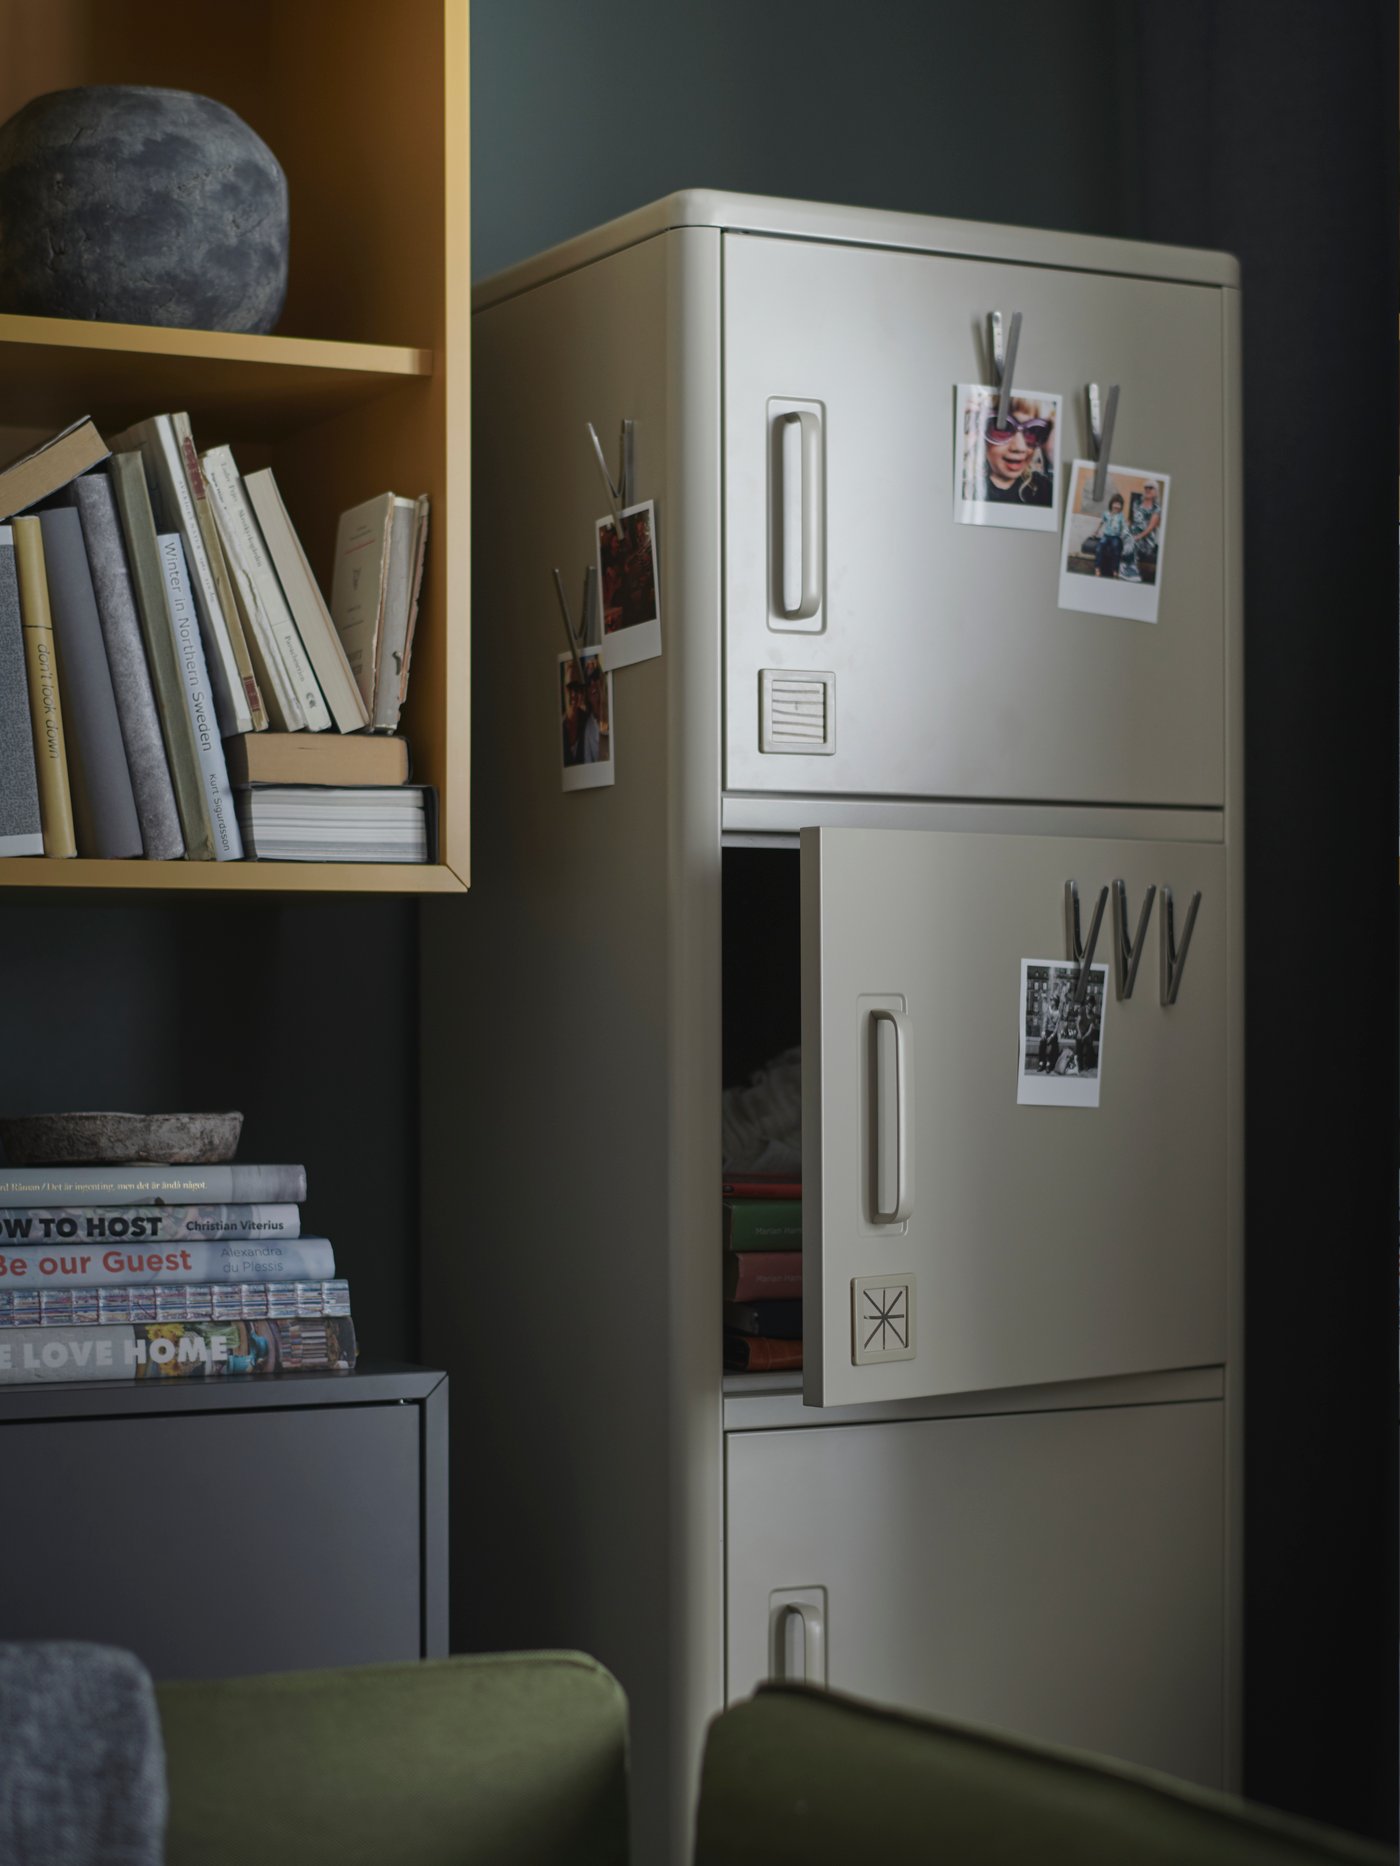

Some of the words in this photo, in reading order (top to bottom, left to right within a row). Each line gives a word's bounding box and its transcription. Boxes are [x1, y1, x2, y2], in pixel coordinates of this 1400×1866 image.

[164, 542, 182, 592] Winter
[174, 598, 186, 611] in
[37, 644, 53, 679] don't
[178, 617, 200, 686] Northern
[41, 684, 56, 714] look
[192, 692, 212, 751] Sweden
[45, 719, 59, 759] down
[209, 773, 220, 796] Kurt
[213, 798, 230, 851] Sigurdsson
[137, 1181, 150, 1190] det
[0, 1217, 34, 1239] W
[38, 1217, 79, 1239] TO
[86, 1215, 163, 1238] HOST
[186, 1220, 238, 1231] Christian
[240, 1219, 284, 1231] Viterius
[38, 1255, 91, 1276] our
[102, 1250, 192, 1274] Guest
[220, 1247, 283, 1258] Alexandra
[223, 1261, 237, 1273] du
[243, 1260, 284, 1273] Plessis
[24, 1340, 113, 1369] LOVE
[124, 1336, 228, 1365] HOME
